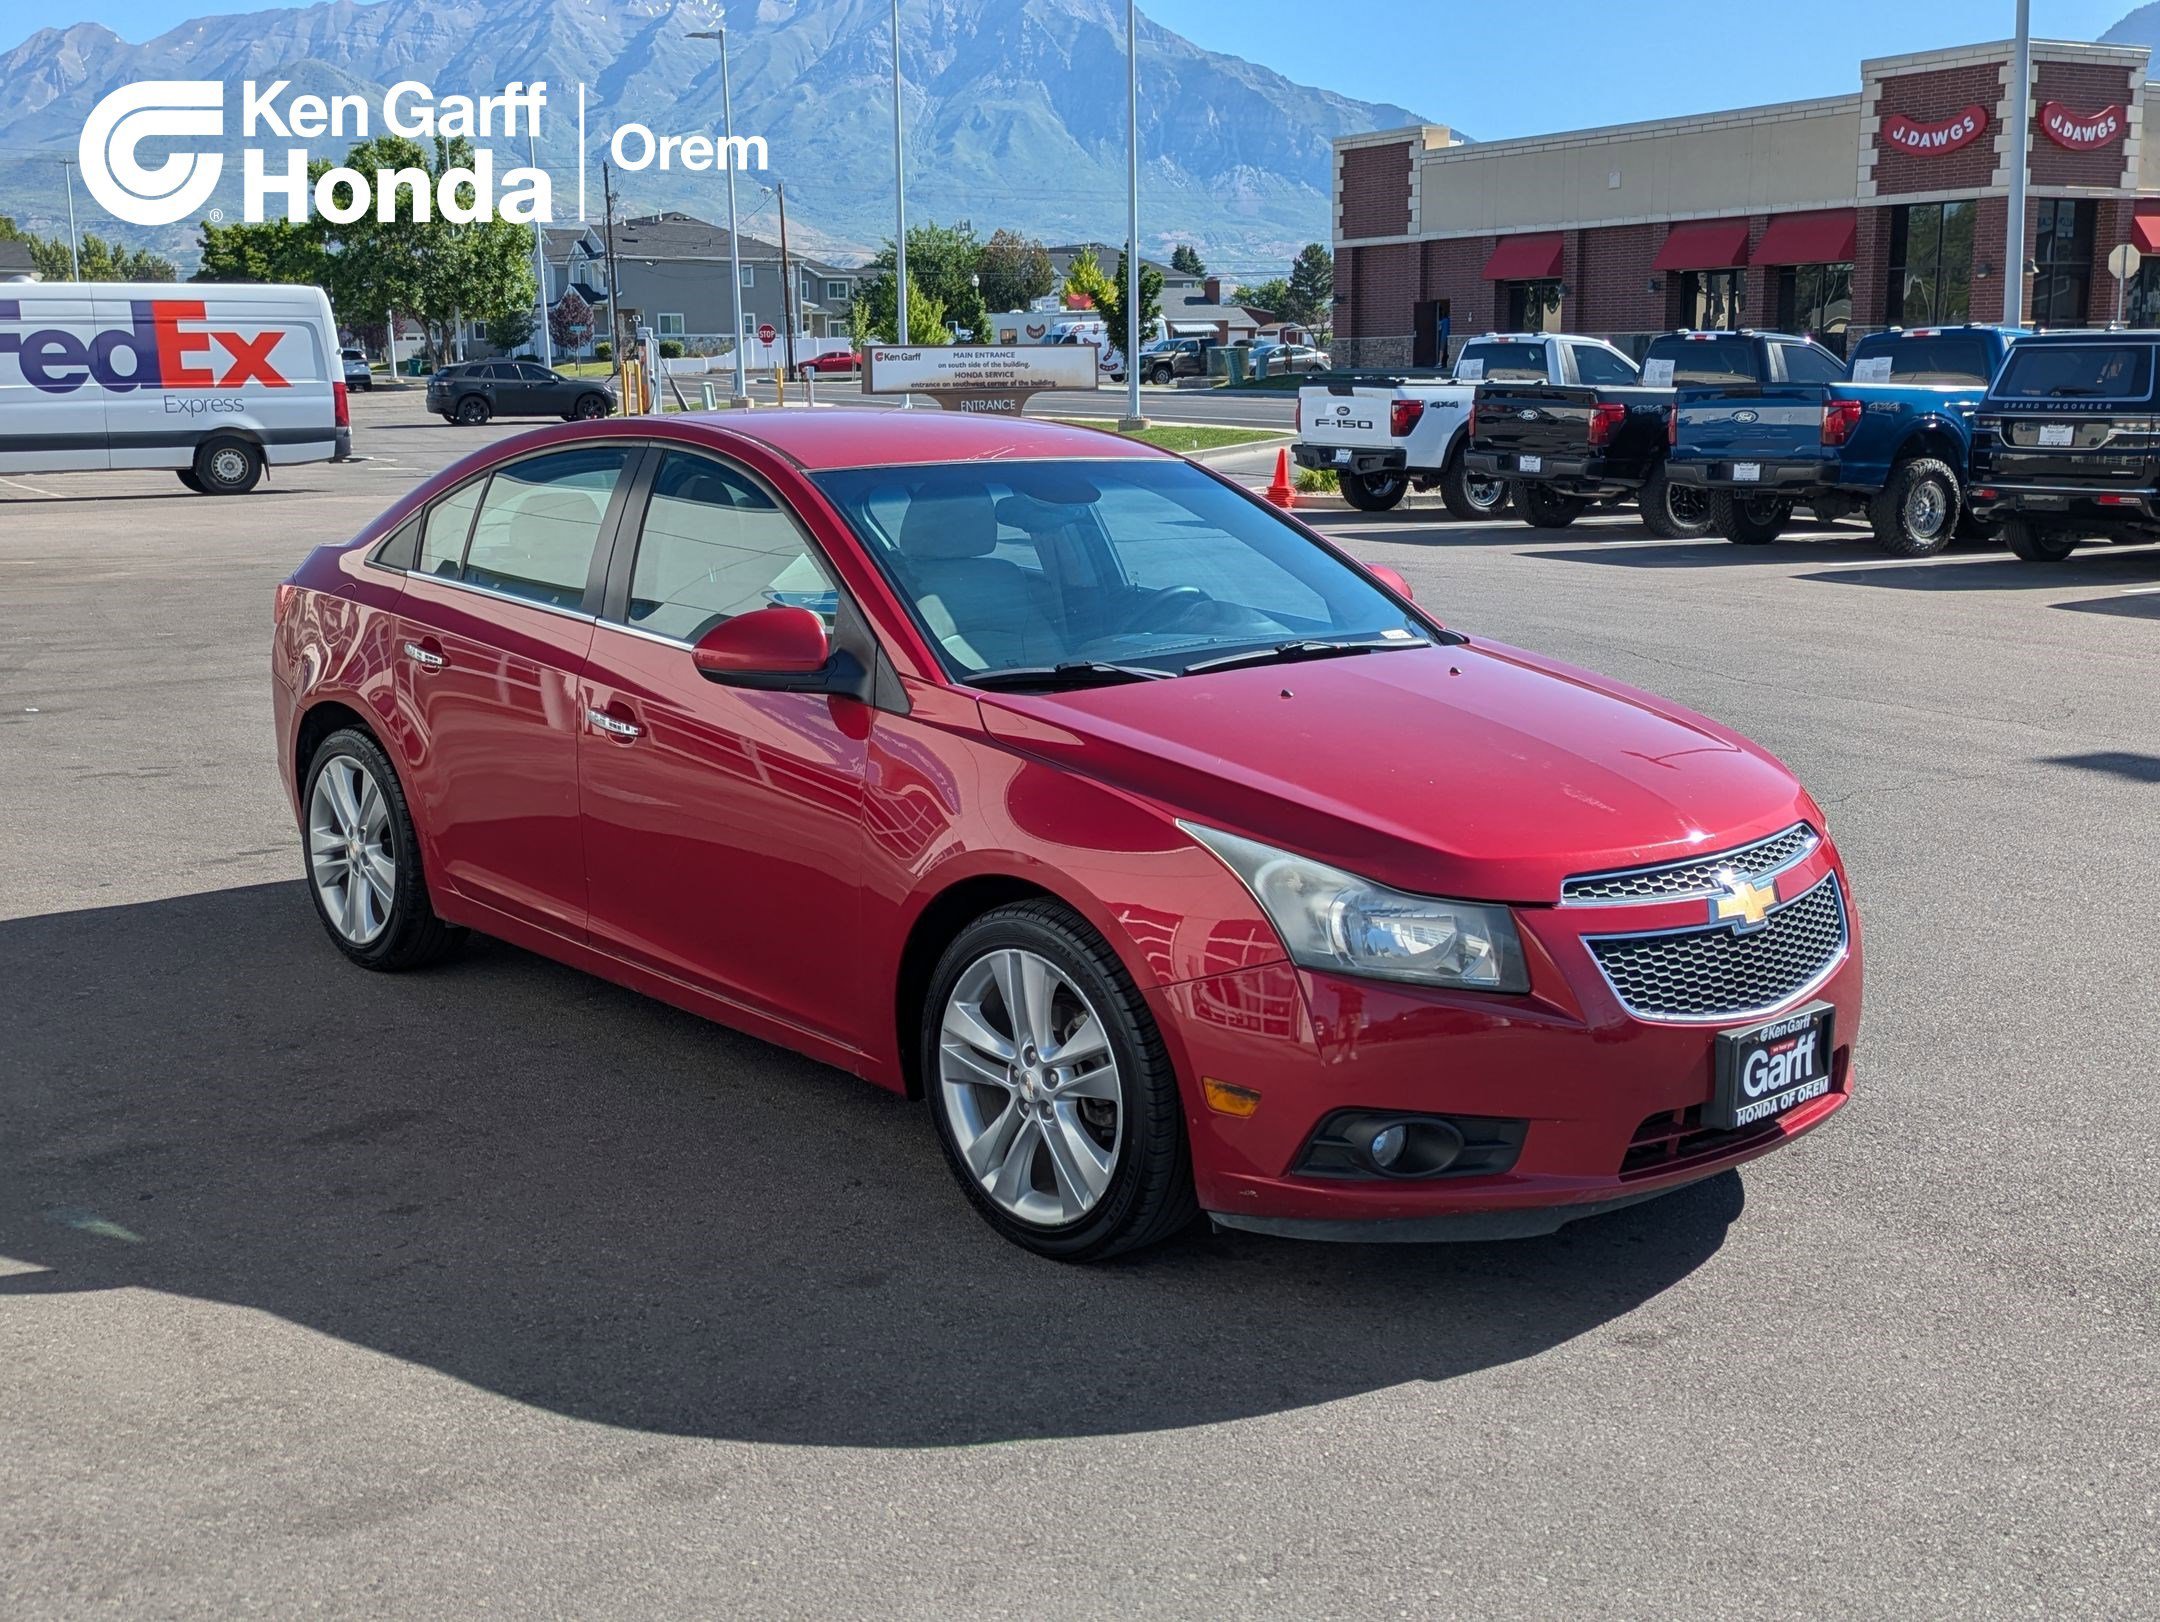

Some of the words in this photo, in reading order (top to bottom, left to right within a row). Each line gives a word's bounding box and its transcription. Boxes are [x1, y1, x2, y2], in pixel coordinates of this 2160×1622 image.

[1893, 116, 1975, 148] J.DAWGS
[2051, 114, 2117, 142] J.DAWGS
[759, 330, 775, 339] STOP
[884, 352, 900, 361] Ken
[901, 352, 921, 361] Garff
[952, 380, 986, 388] southwest
[163, 395, 245, 418] Express
[960, 400, 1016, 413] ENTRANCE
[1314, 418, 1374, 430] F-150
[1768, 1026, 1786, 1039] Ken
[1787, 1014, 1811, 1032] Garff
[1743, 1031, 1817, 1097] Garff
[1736, 1099, 1778, 1127] HONDA
[1781, 1091, 1797, 1110] OF
[1798, 1078, 1829, 1103] OREM
